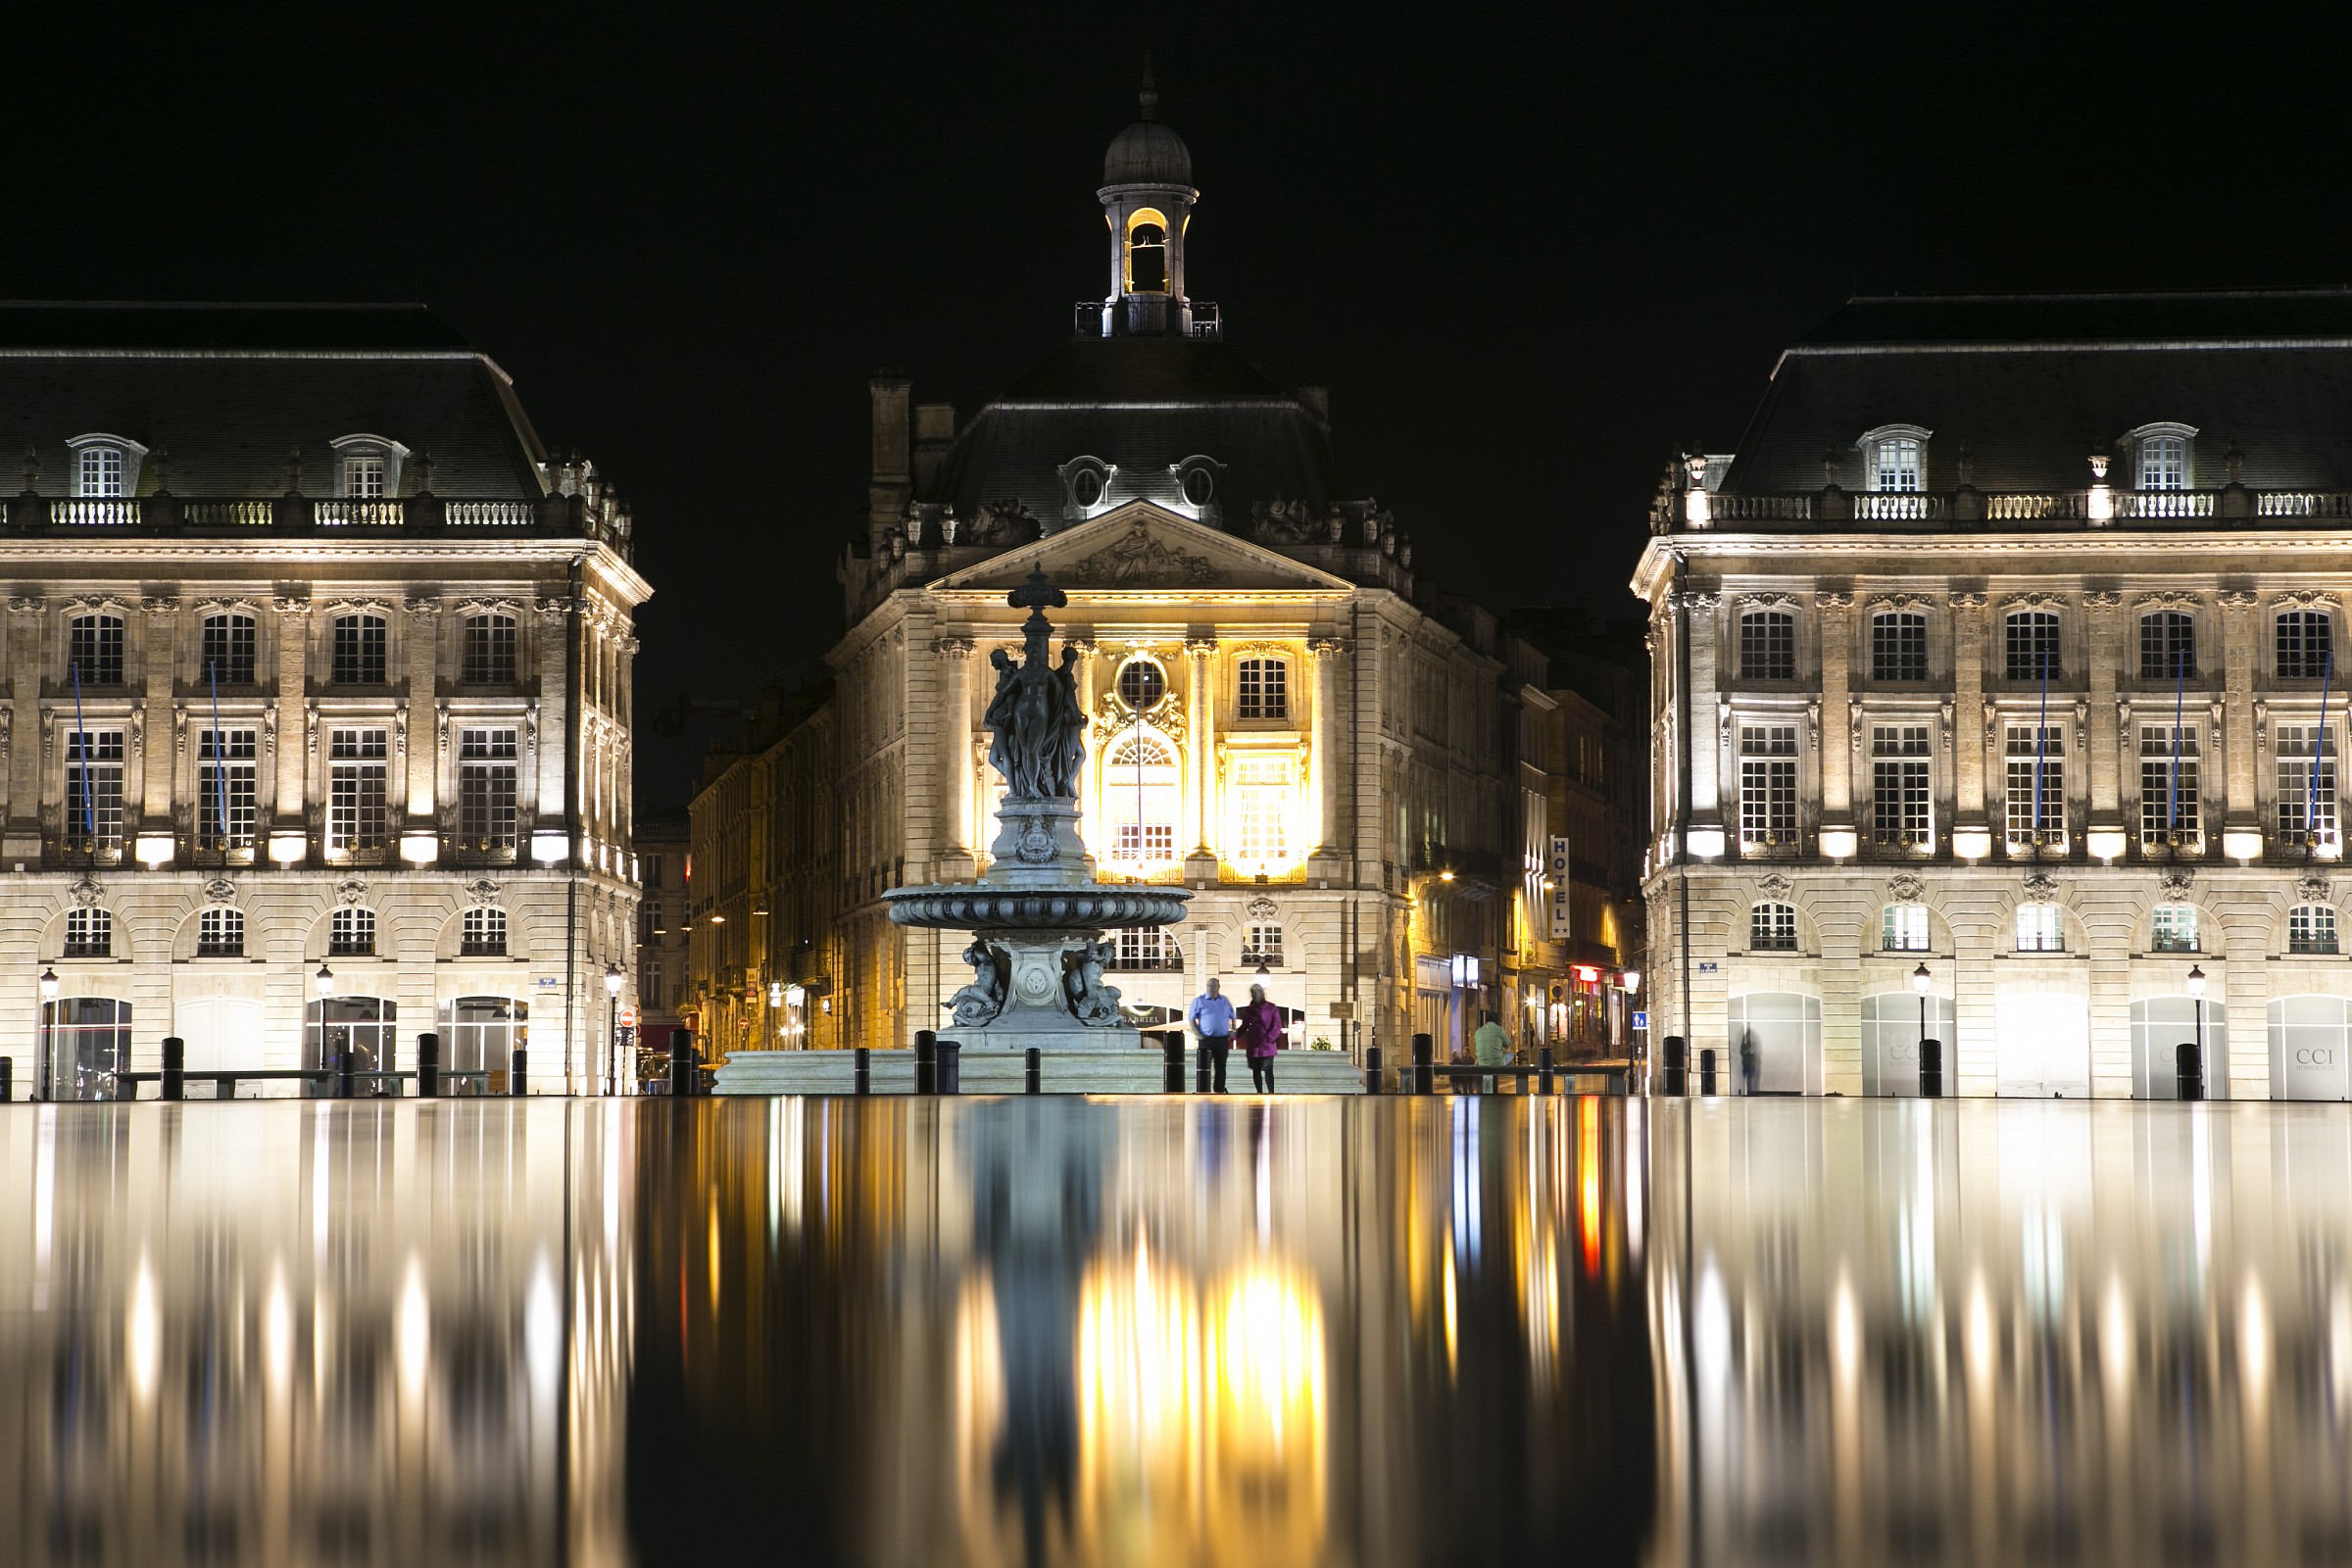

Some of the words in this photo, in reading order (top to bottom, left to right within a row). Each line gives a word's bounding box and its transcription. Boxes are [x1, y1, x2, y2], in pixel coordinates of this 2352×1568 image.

[1553, 841, 1566, 920] HOTEL
[1889, 1045, 1919, 1060] CC
[2296, 1049, 2333, 1065] CCI
